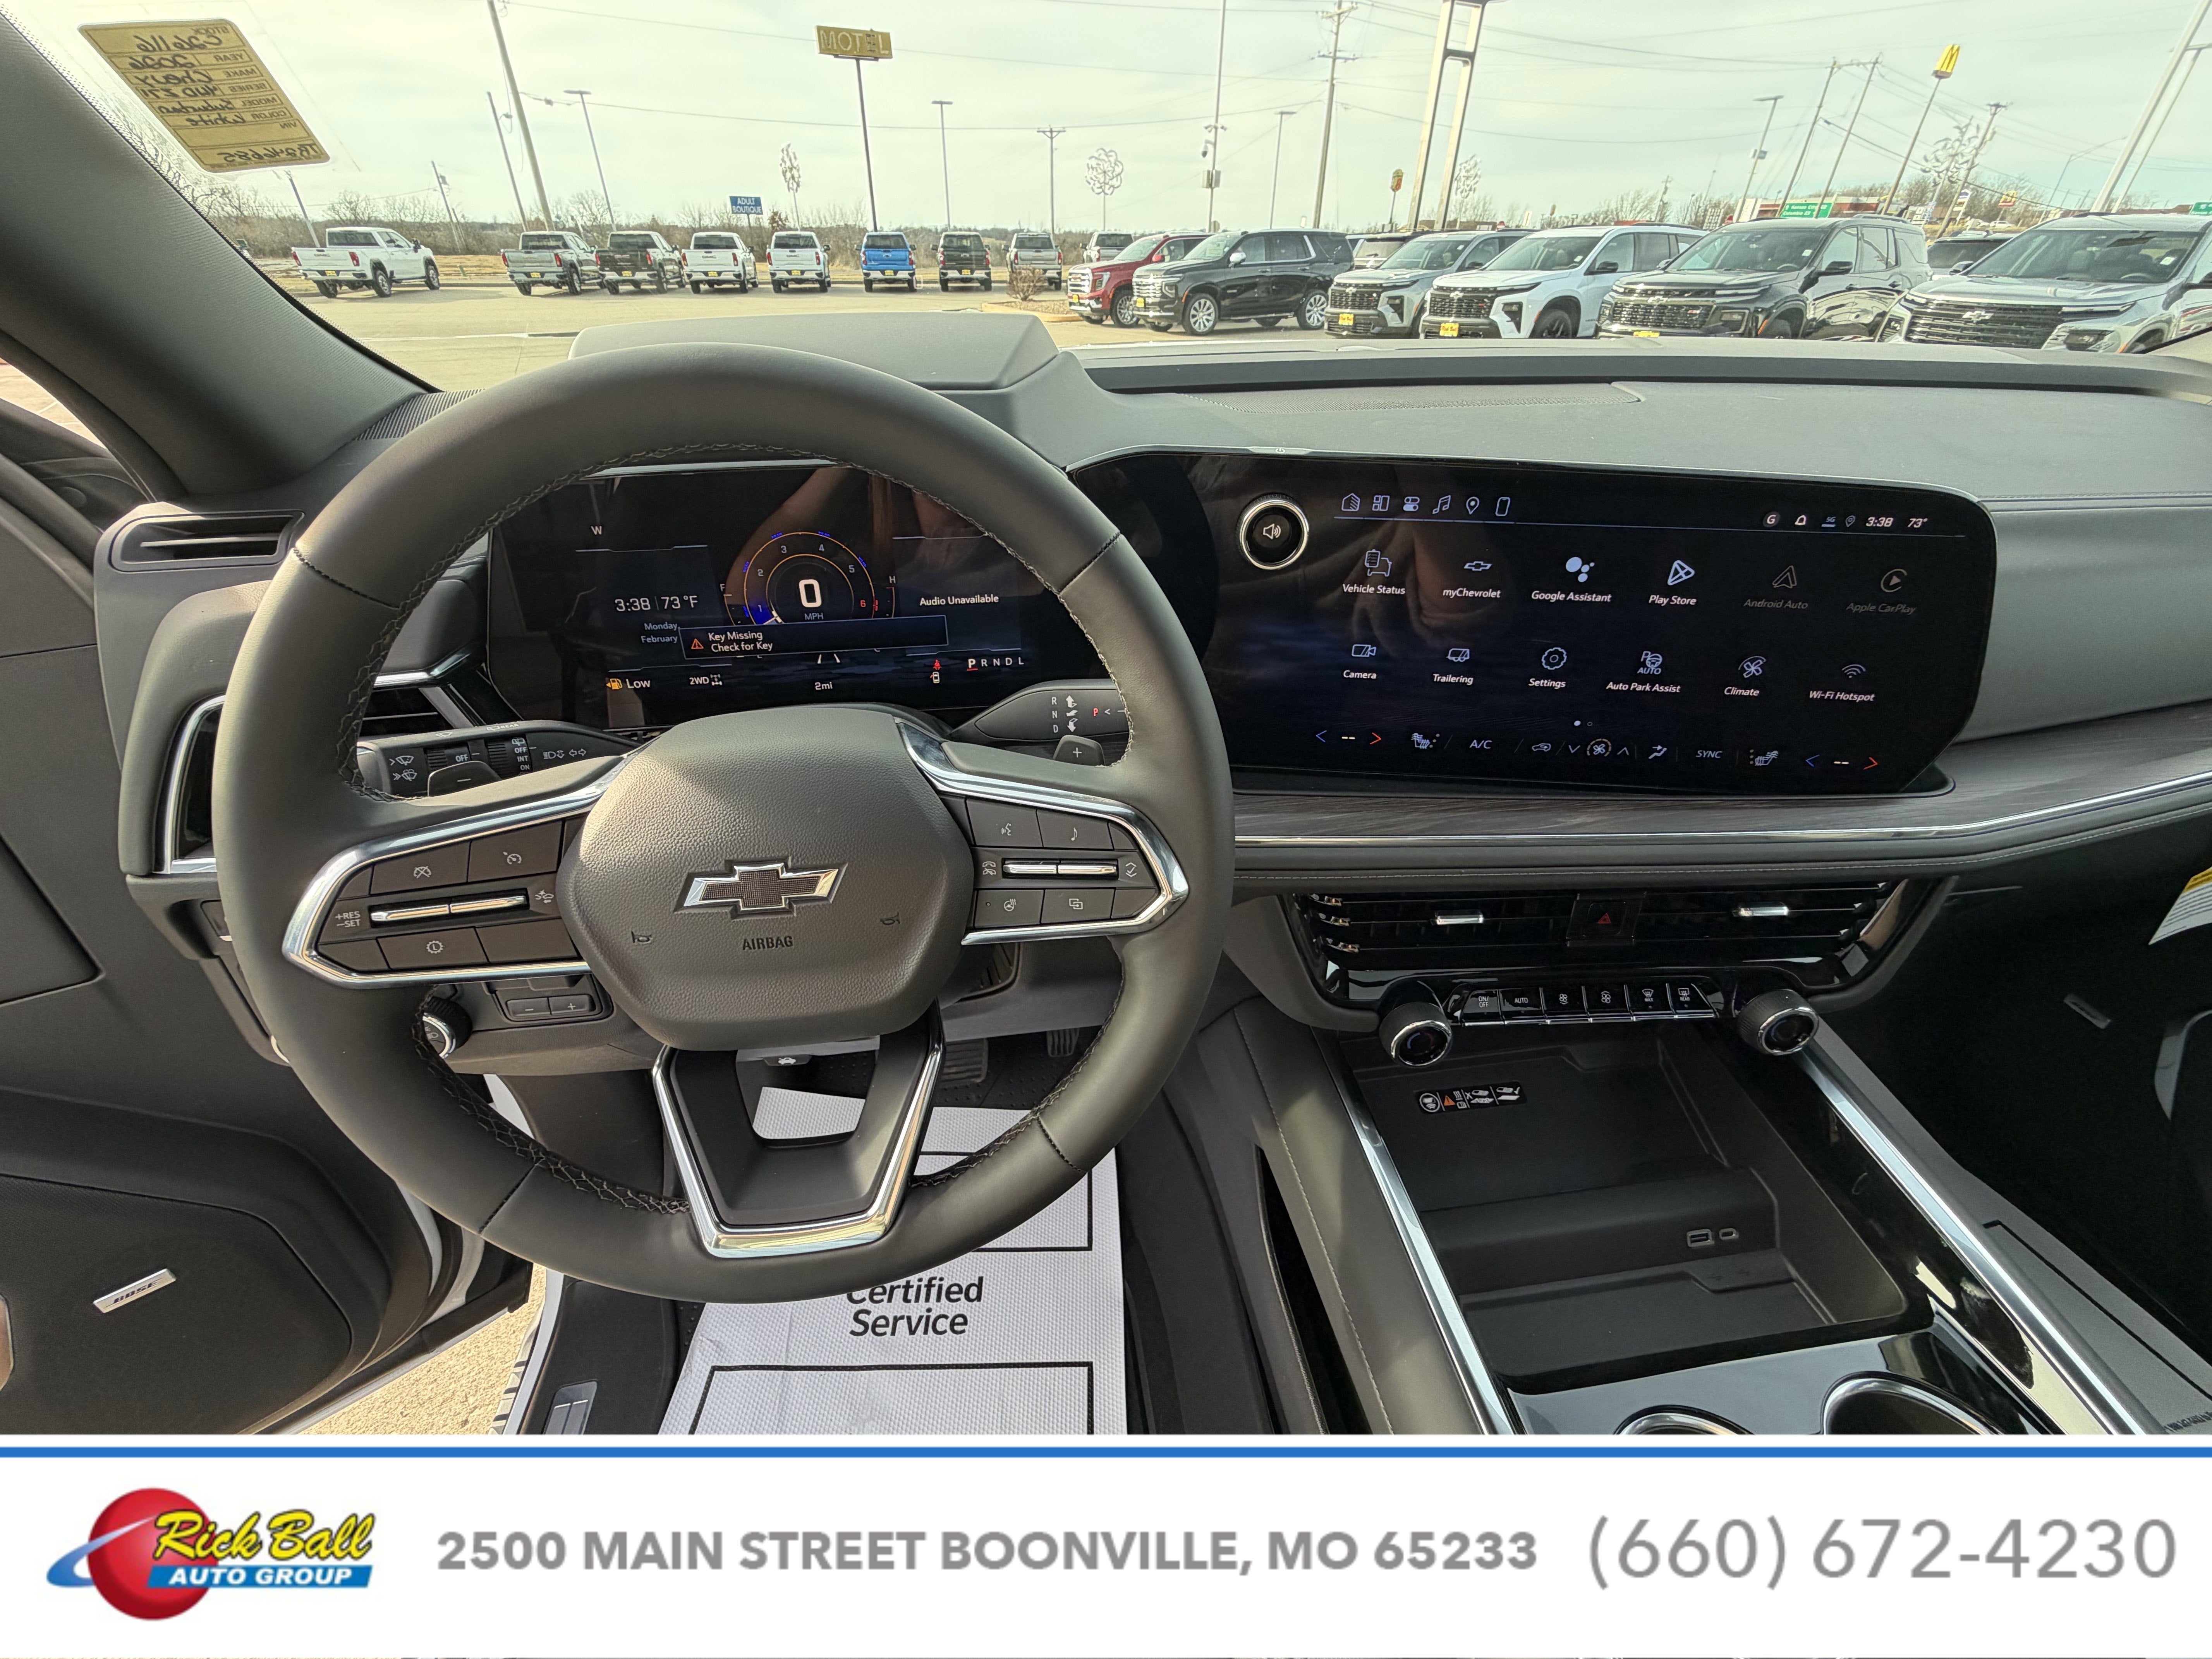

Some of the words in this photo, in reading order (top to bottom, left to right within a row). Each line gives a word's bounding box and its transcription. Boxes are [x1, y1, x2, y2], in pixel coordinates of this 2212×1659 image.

[820, 30, 890, 54] MOTEL
[1865, 517, 1893, 528] 3:38
[591, 526, 603, 536] W
[780, 545, 787, 553] 3
[818, 544, 825, 552] 4
[848, 565, 855, 573] 5
[889, 575, 896, 584] H
[720, 584, 726, 592] F
[799, 579, 822, 608] 0
[1342, 584, 1375, 593] Vehicle
[1377, 585, 1406, 595] Status
[1443, 587, 1501, 599] myChevrolet
[919, 596, 946, 606] Audio
[948, 594, 1000, 605] Unavailable
[1531, 591, 1565, 602] Google
[1566, 592, 1612, 602] Assistant
[1649, 594, 1669, 606] Play
[1670, 596, 1697, 606] Store
[614, 598, 651, 612] 3:38
[860, 599, 866, 608] 6
[1743, 598, 1783, 608] Android
[1784, 600, 1808, 610] Auto
[1846, 603, 1877, 613] Apple
[1878, 604, 1917, 614] CarPlay
[804, 612, 824, 620] MPH
[644, 622, 678, 631] Monday
[641, 635, 678, 644] February
[708, 633, 726, 642] Key
[727, 631, 763, 642] Missing
[711, 642, 739, 653] Check
[740, 642, 755, 651] for
[756, 641, 773, 652] Key
[968, 659, 976, 668] P
[981, 659, 988, 667] R
[993, 658, 1000, 666] N
[1005, 658, 1013, 666] D
[1018, 657, 1024, 665] L
[1343, 670, 1377, 679] Camera
[1433, 673, 1474, 685] Trailering
[626, 678, 651, 689] Low
[689, 677, 709, 685] 2WD
[814, 681, 833, 690] 2mi
[1528, 678, 1566, 688] Settings
[1606, 681, 1628, 691] Auto
[1630, 682, 1652, 692] Park
[1652, 683, 1681, 693] Assist
[1724, 686, 1760, 697] Climate
[1051, 697, 1058, 705] R
[1809, 690, 1834, 700] Wi-Fi
[1835, 692, 1875, 702] Hotspot
[1052, 710, 1058, 719] N
[1093, 708, 1099, 716] P
[1053, 725, 1059, 733] D
[1469, 740, 1492, 749] A/C
[1695, 749, 1723, 759] SYNC
[742, 935, 794, 951] AIRBAG
[849, 1307, 968, 1336] Service
